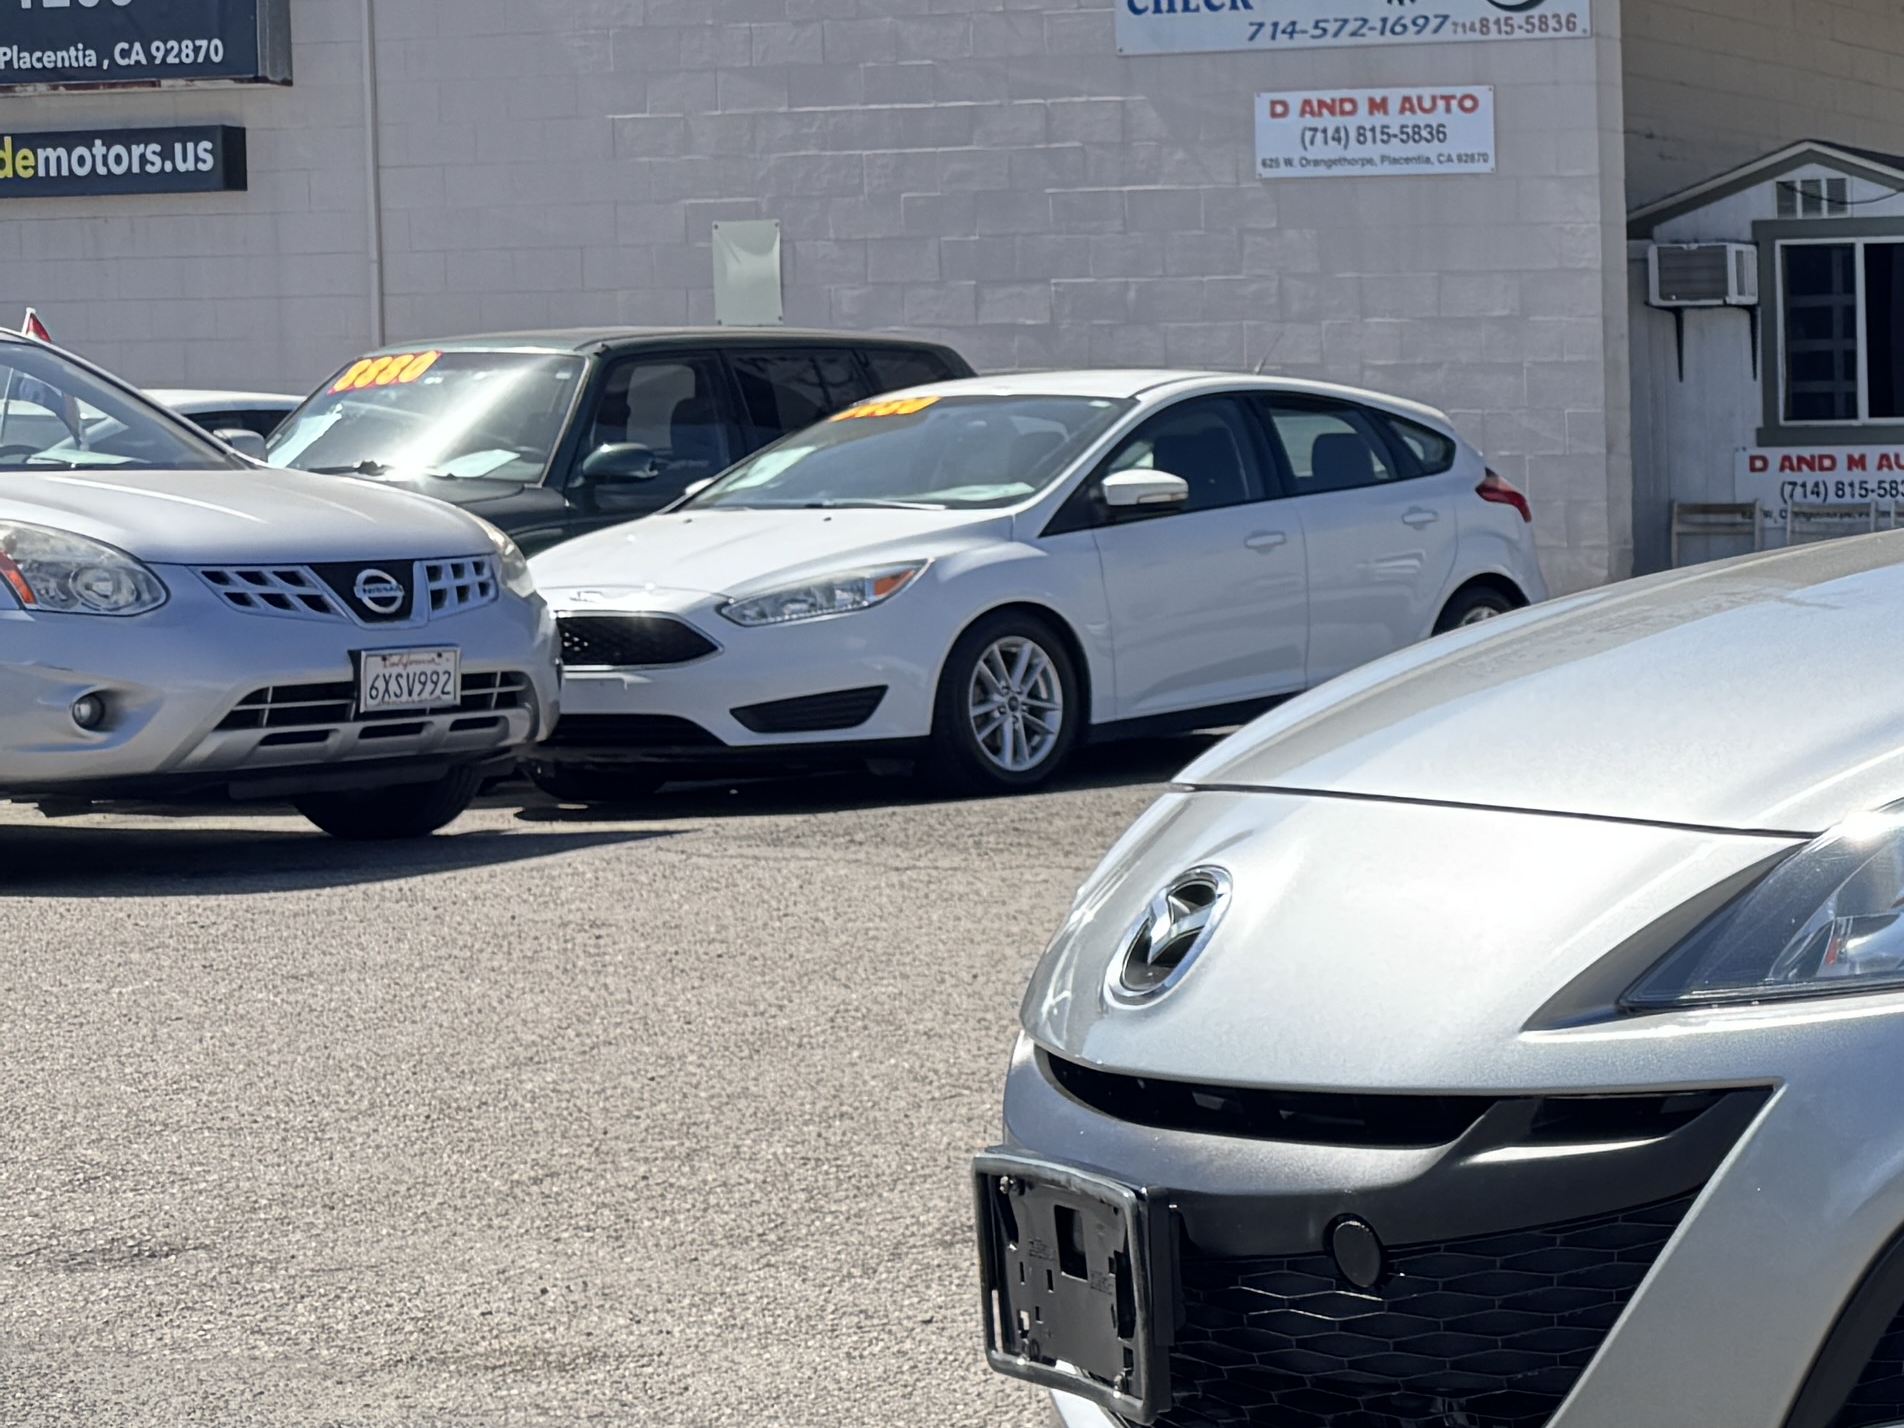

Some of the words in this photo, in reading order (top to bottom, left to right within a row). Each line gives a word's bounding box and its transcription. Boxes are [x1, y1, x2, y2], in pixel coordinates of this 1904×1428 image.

[1247, 14, 1451, 43] 714-572-1697
[113, 42, 148, 66] CA
[150, 38, 224, 65] 92870
[1269, 99, 1290, 119] D
[1299, 97, 1359, 118] AND
[1367, 96, 1389, 116] M
[1398, 93, 1480, 115] AUTO
[1301, 125, 1350, 151] (714)
[1356, 123, 1448, 145] 815-5836
[1748, 454, 1769, 473] D
[1779, 453, 1838, 473] AND
[1846, 453, 1867, 472] M
[1780, 480, 1829, 504] (714)
[368, 669, 452, 701] 6XSV992
